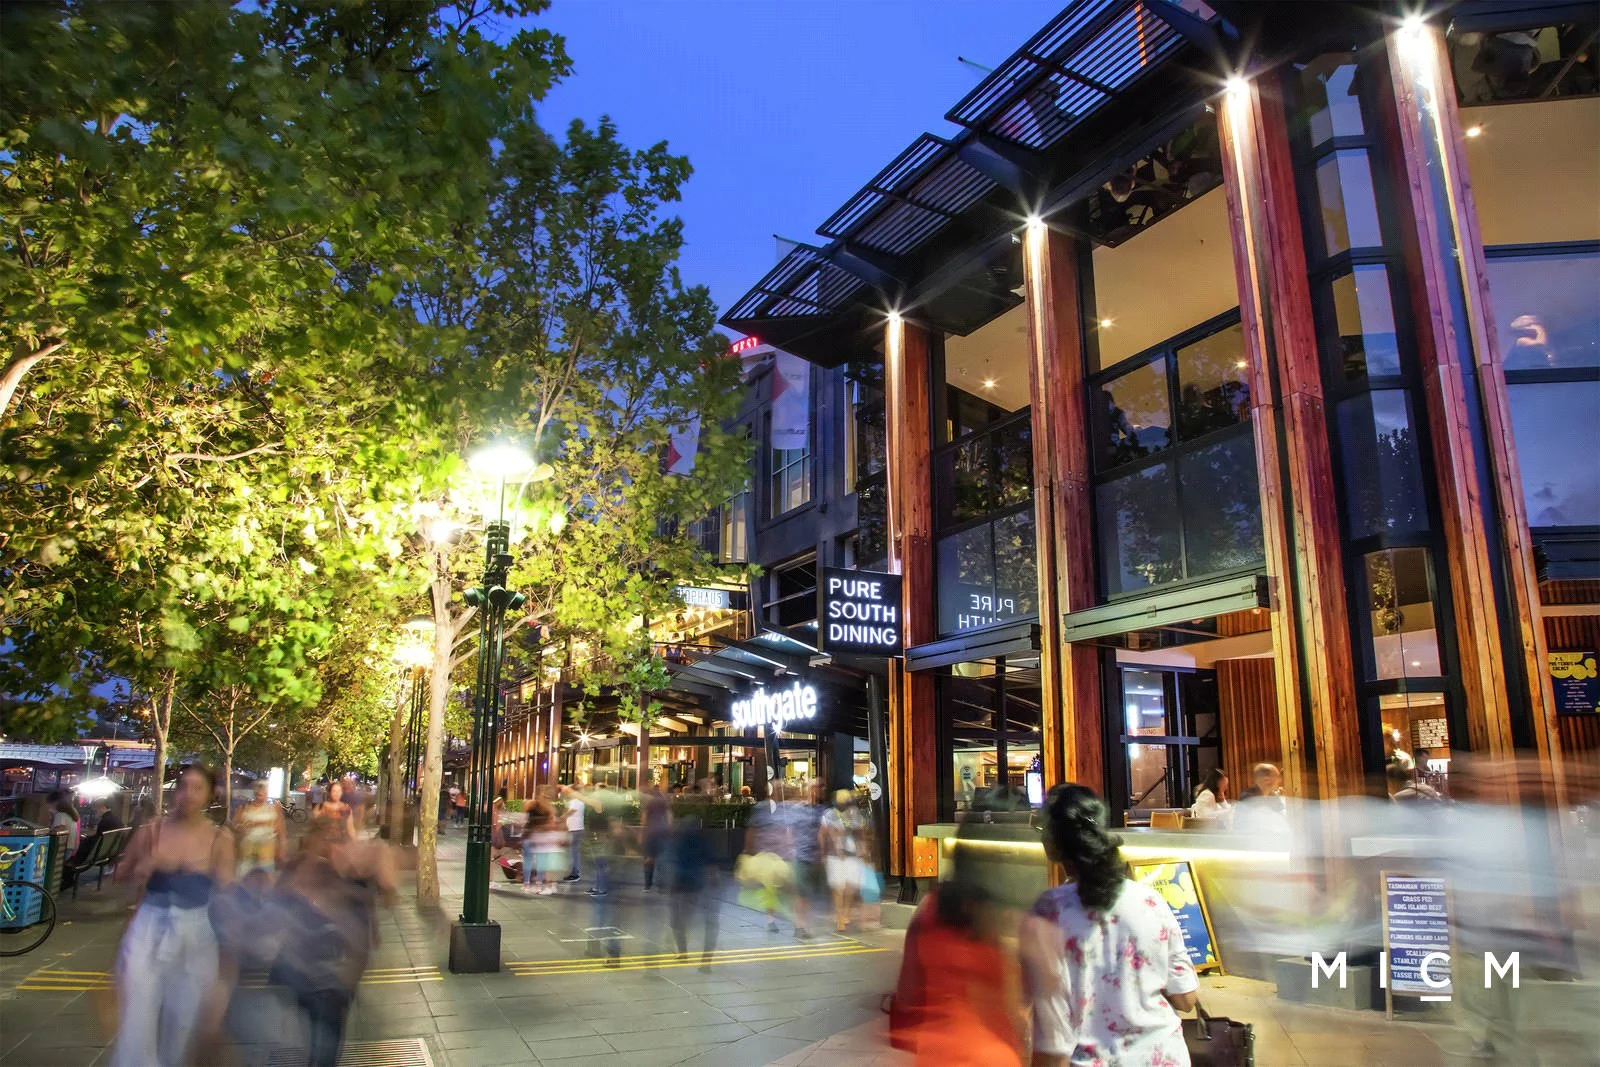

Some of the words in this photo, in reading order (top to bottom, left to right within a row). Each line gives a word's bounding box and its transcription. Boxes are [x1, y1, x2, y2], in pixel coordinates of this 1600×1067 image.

[829, 578, 882, 600] PURE
[829, 600, 896, 623] SOUTH
[830, 623, 898, 646] DINING
[732, 681, 817, 731] southgate
